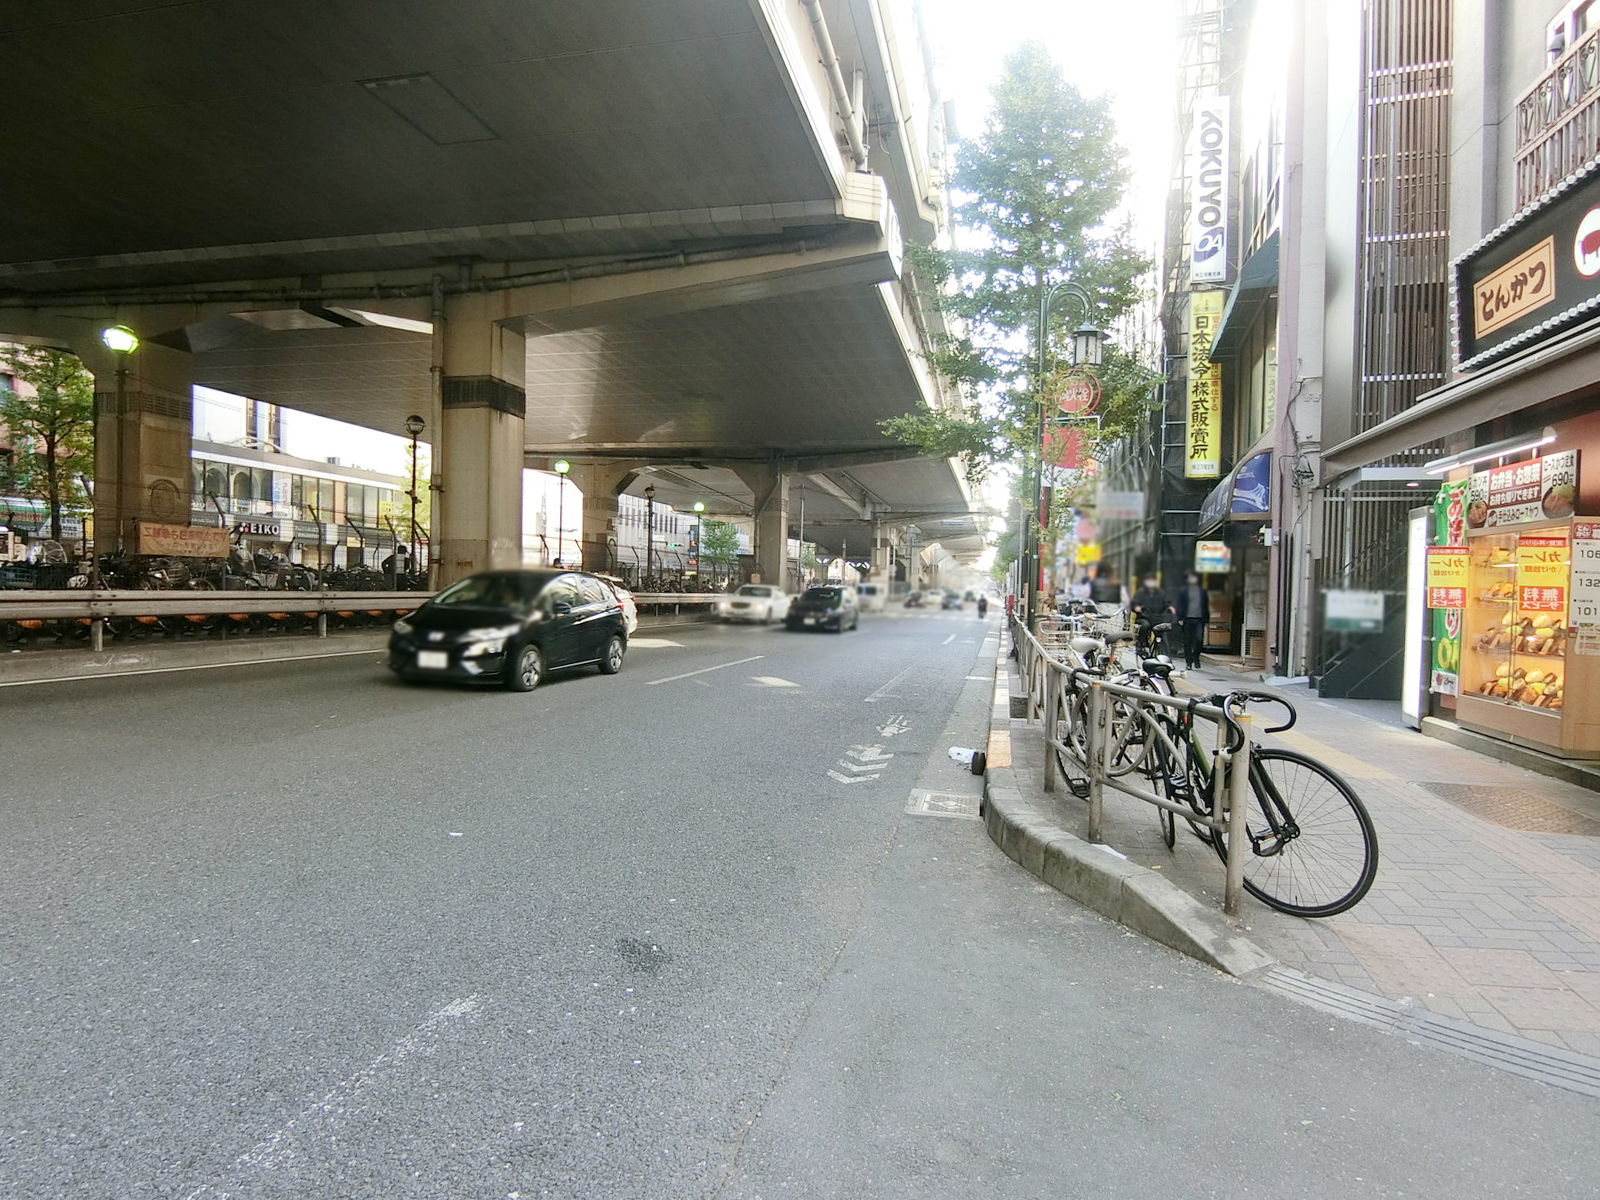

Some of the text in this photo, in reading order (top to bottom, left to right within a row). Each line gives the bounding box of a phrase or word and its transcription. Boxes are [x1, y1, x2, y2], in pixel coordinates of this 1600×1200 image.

[1198, 109, 1223, 228] KOKUYO
[1195, 234, 1223, 253] OA
[1489, 486, 1540, 505] お持ち帰りできます
